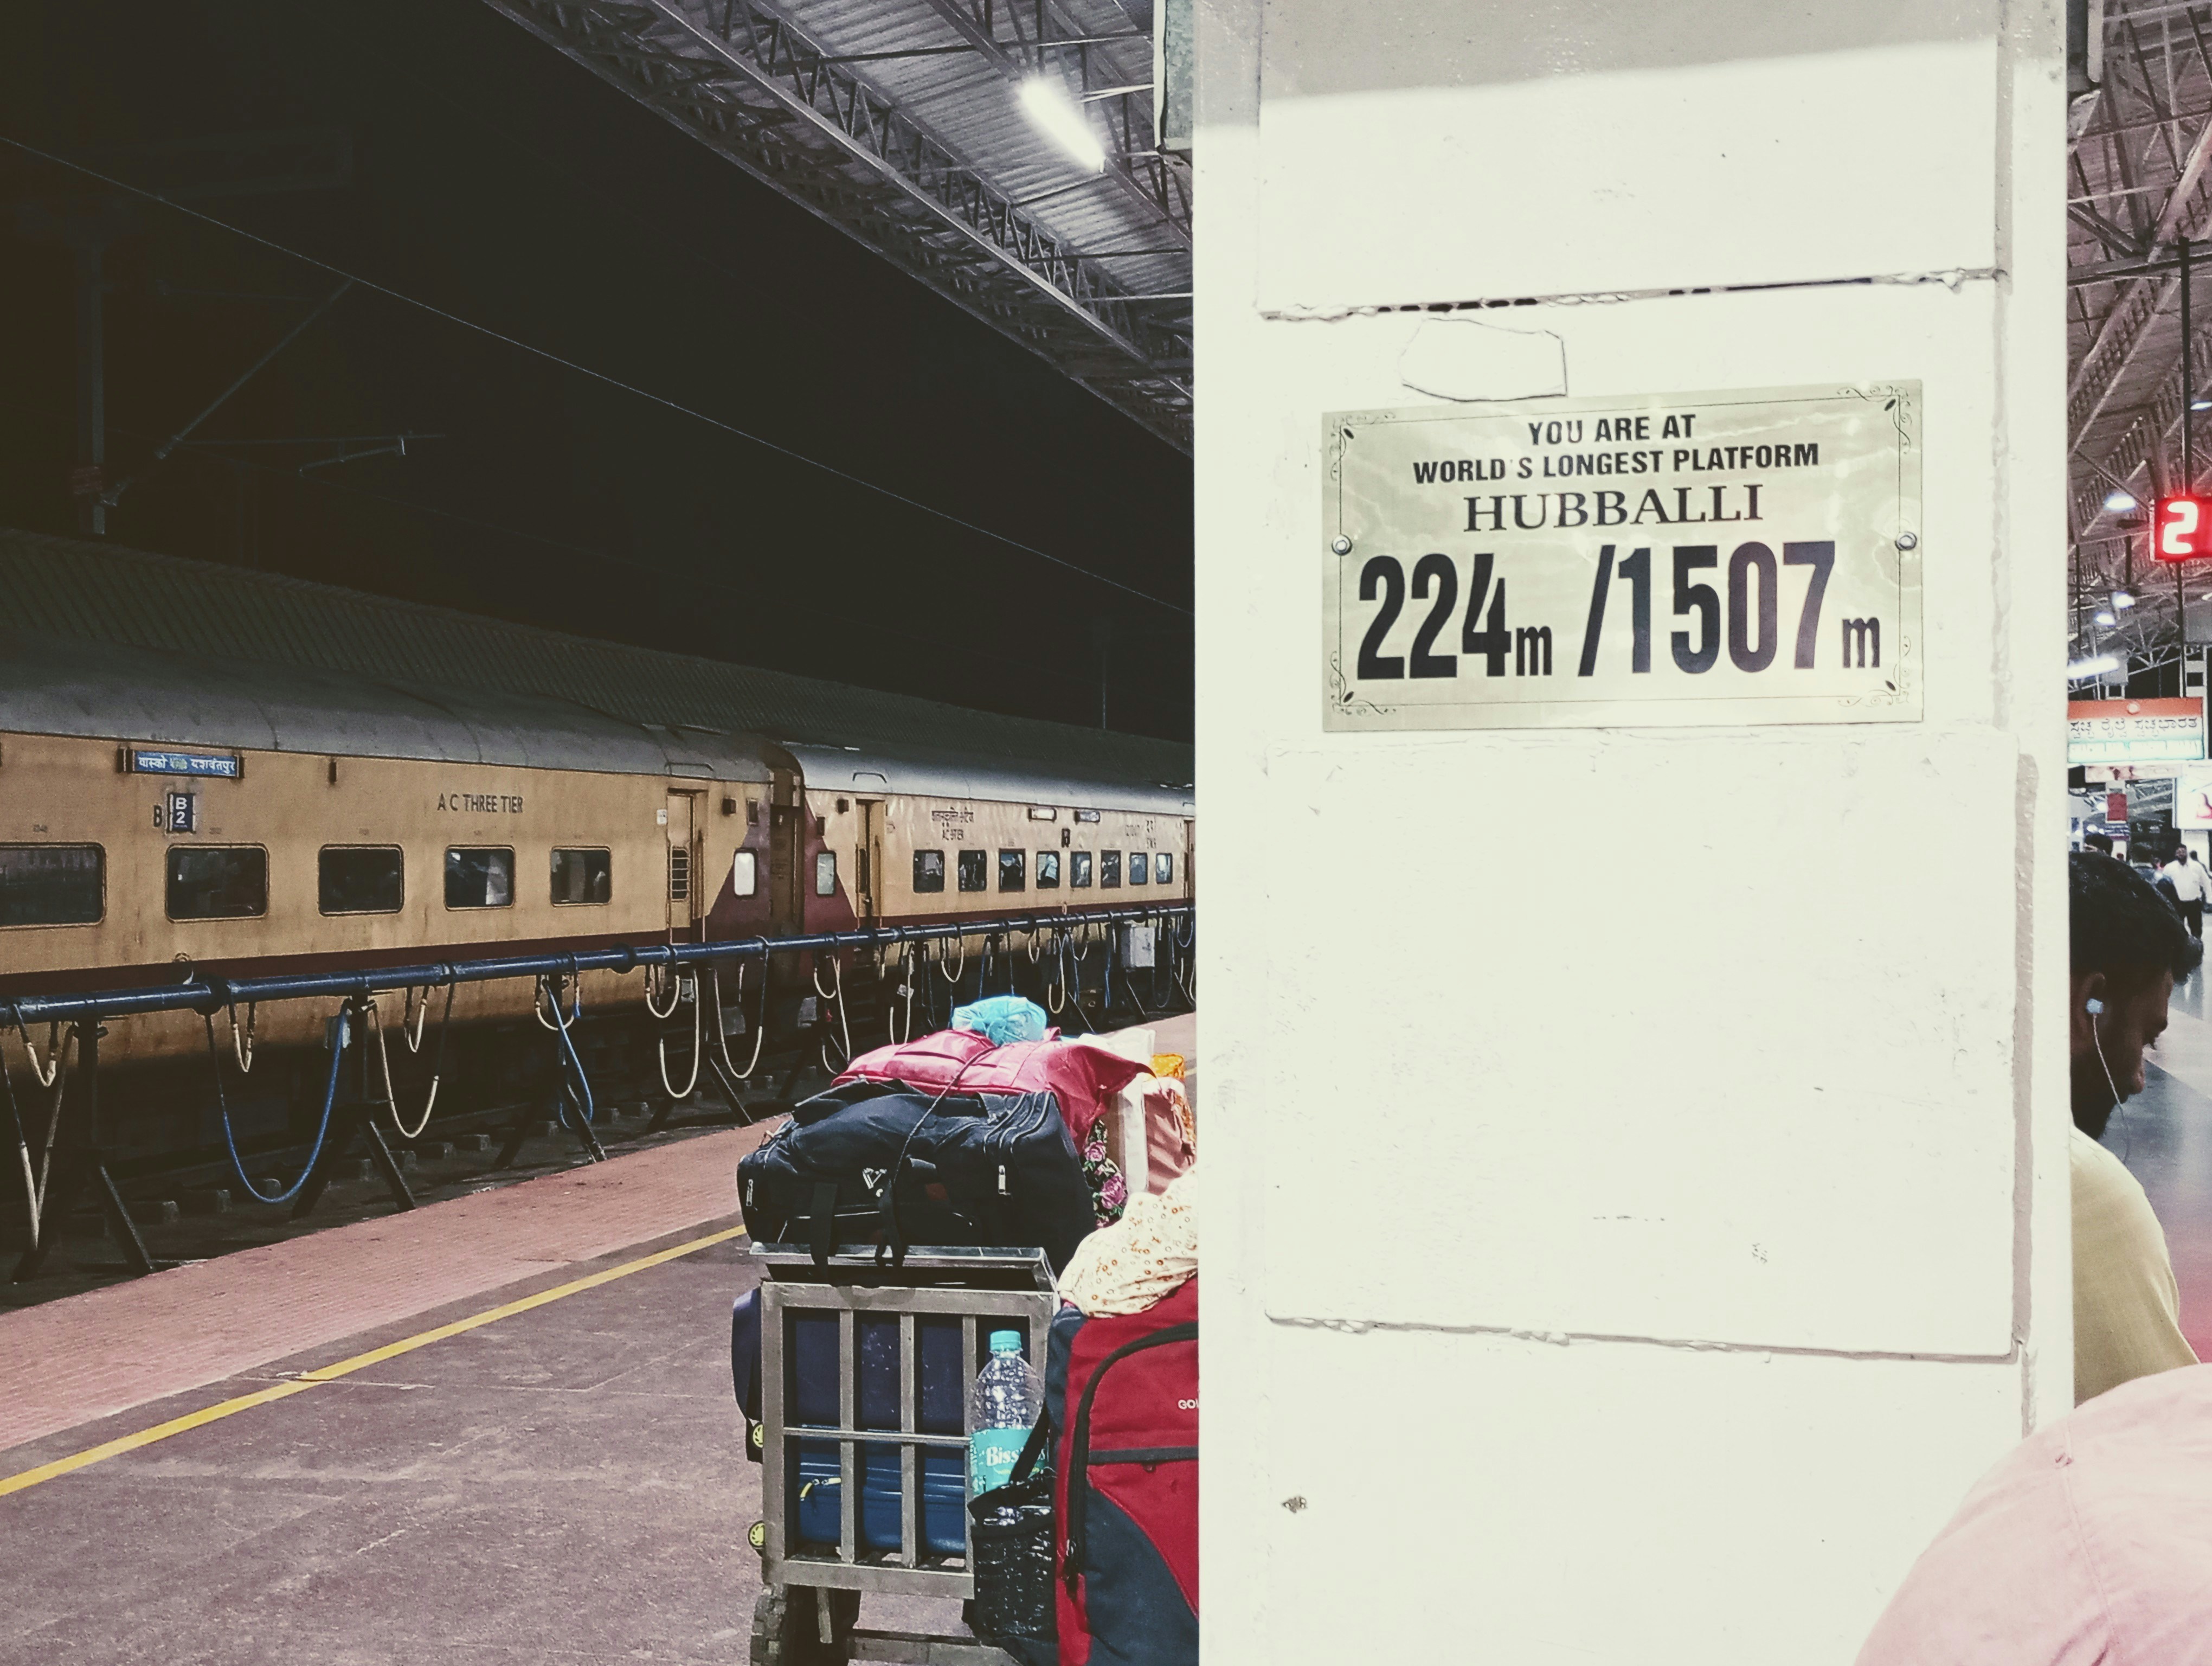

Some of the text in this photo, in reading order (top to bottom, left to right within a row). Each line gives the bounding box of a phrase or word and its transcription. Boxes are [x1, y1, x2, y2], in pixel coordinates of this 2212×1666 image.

[1529, 414, 1696, 446] YOU ARE AT
[1544, 451, 1664, 478] LONGEST
[1674, 443, 1819, 473] PLATFORM
[1463, 484, 1764, 533] HUBBALLI
[2163, 501, 2198, 554] 2
[153, 805, 163, 827] B
[462, 794, 497, 812] THREE
[500, 796, 523, 813] TIER
[986, 1446, 1024, 1467] Biss
